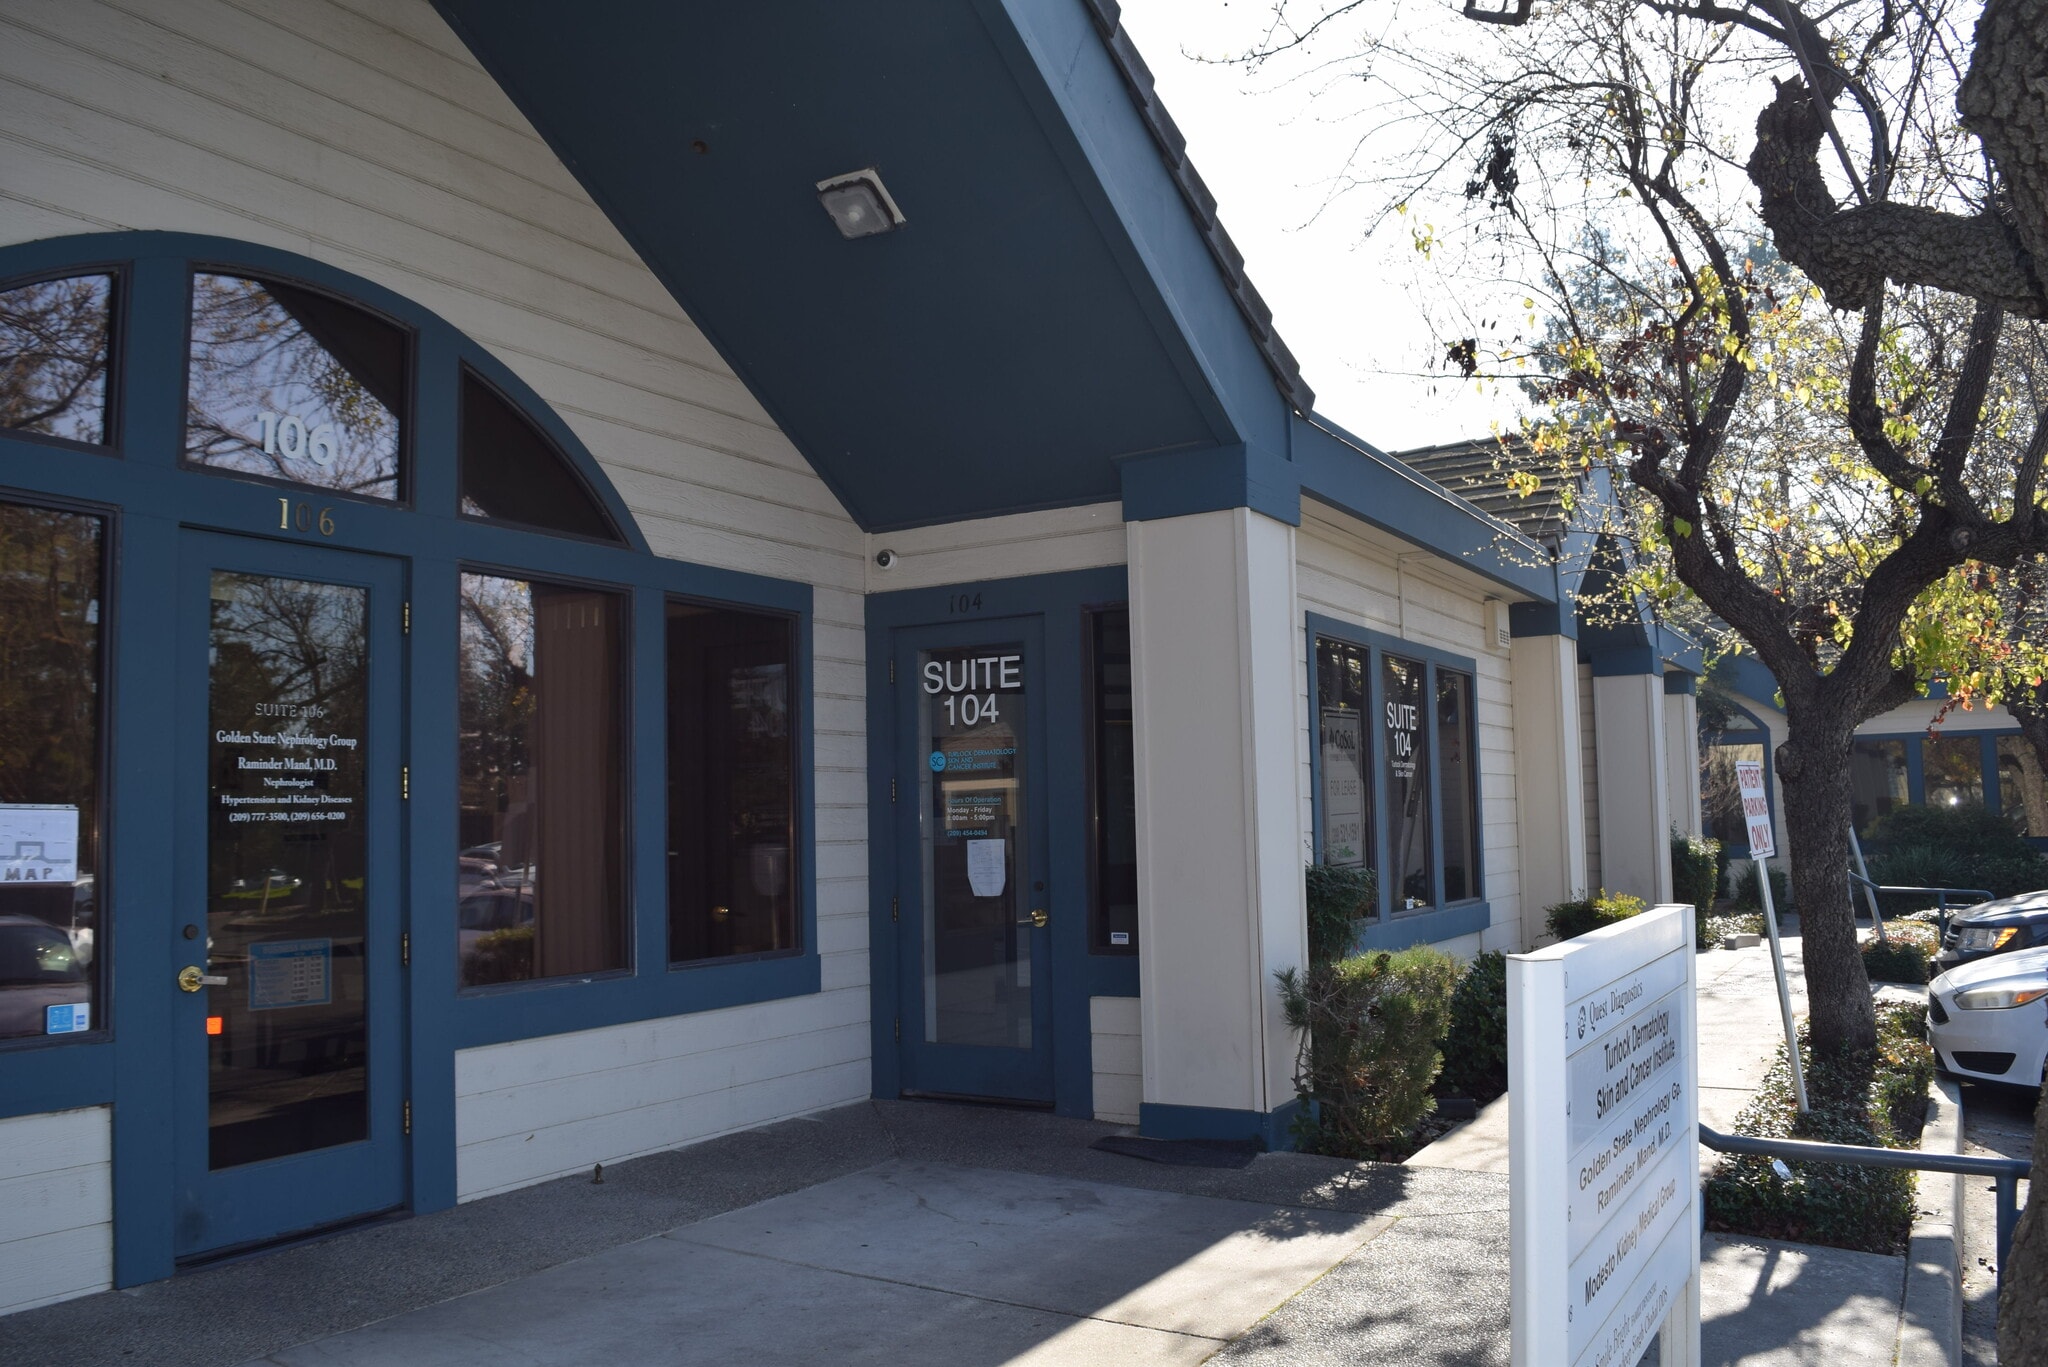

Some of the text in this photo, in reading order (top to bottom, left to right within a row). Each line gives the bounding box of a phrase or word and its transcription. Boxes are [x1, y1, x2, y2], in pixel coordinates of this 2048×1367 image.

[257, 411, 338, 466] 106
[278, 498, 335, 536] 106
[949, 592, 982, 614] 104
[923, 655, 1021, 694] SUITE
[254, 702, 297, 717] SUITE
[944, 693, 1000, 726] 104
[1386, 701, 1417, 731] SUITE
[216, 730, 358, 750] Golden State Nephrology Group
[974, 748, 1016, 756] DERMATOLOGY
[1394, 730, 1412, 757] 104
[238, 756, 338, 772] Raminder Mand, M.D.
[264, 777, 314, 789] Nephrologist
[1740, 769, 1761, 789] PATIENT
[221, 794, 352, 806] Hypertension and Kidney Diseases
[973, 796, 1002, 805] Operation
[974, 806, 992, 814] Friday
[1744, 797, 1767, 817] PARKING
[228, 812, 251, 822] (209)
[290, 812, 310, 822] (209)
[1752, 824, 1770, 850] ONLY
[4, 868, 53, 881] MAP
[1589, 978, 1643, 1032] Quest Diagnostics
[1604, 1010, 1670, 1072] Turlock Dermatology
[1596, 1037, 1675, 1119] Skin and Cancer Institute
[1580, 1082, 1681, 1191] Golden State Nephrology Gp.
[1598, 1121, 1672, 1214] Raminder Mand, M.D.
[1585, 1177, 1675, 1307] Modesto Kidney Medical Group
[1595, 1338, 1612, 1367] Smile
[1614, 1314, 1630, 1354] Bright
